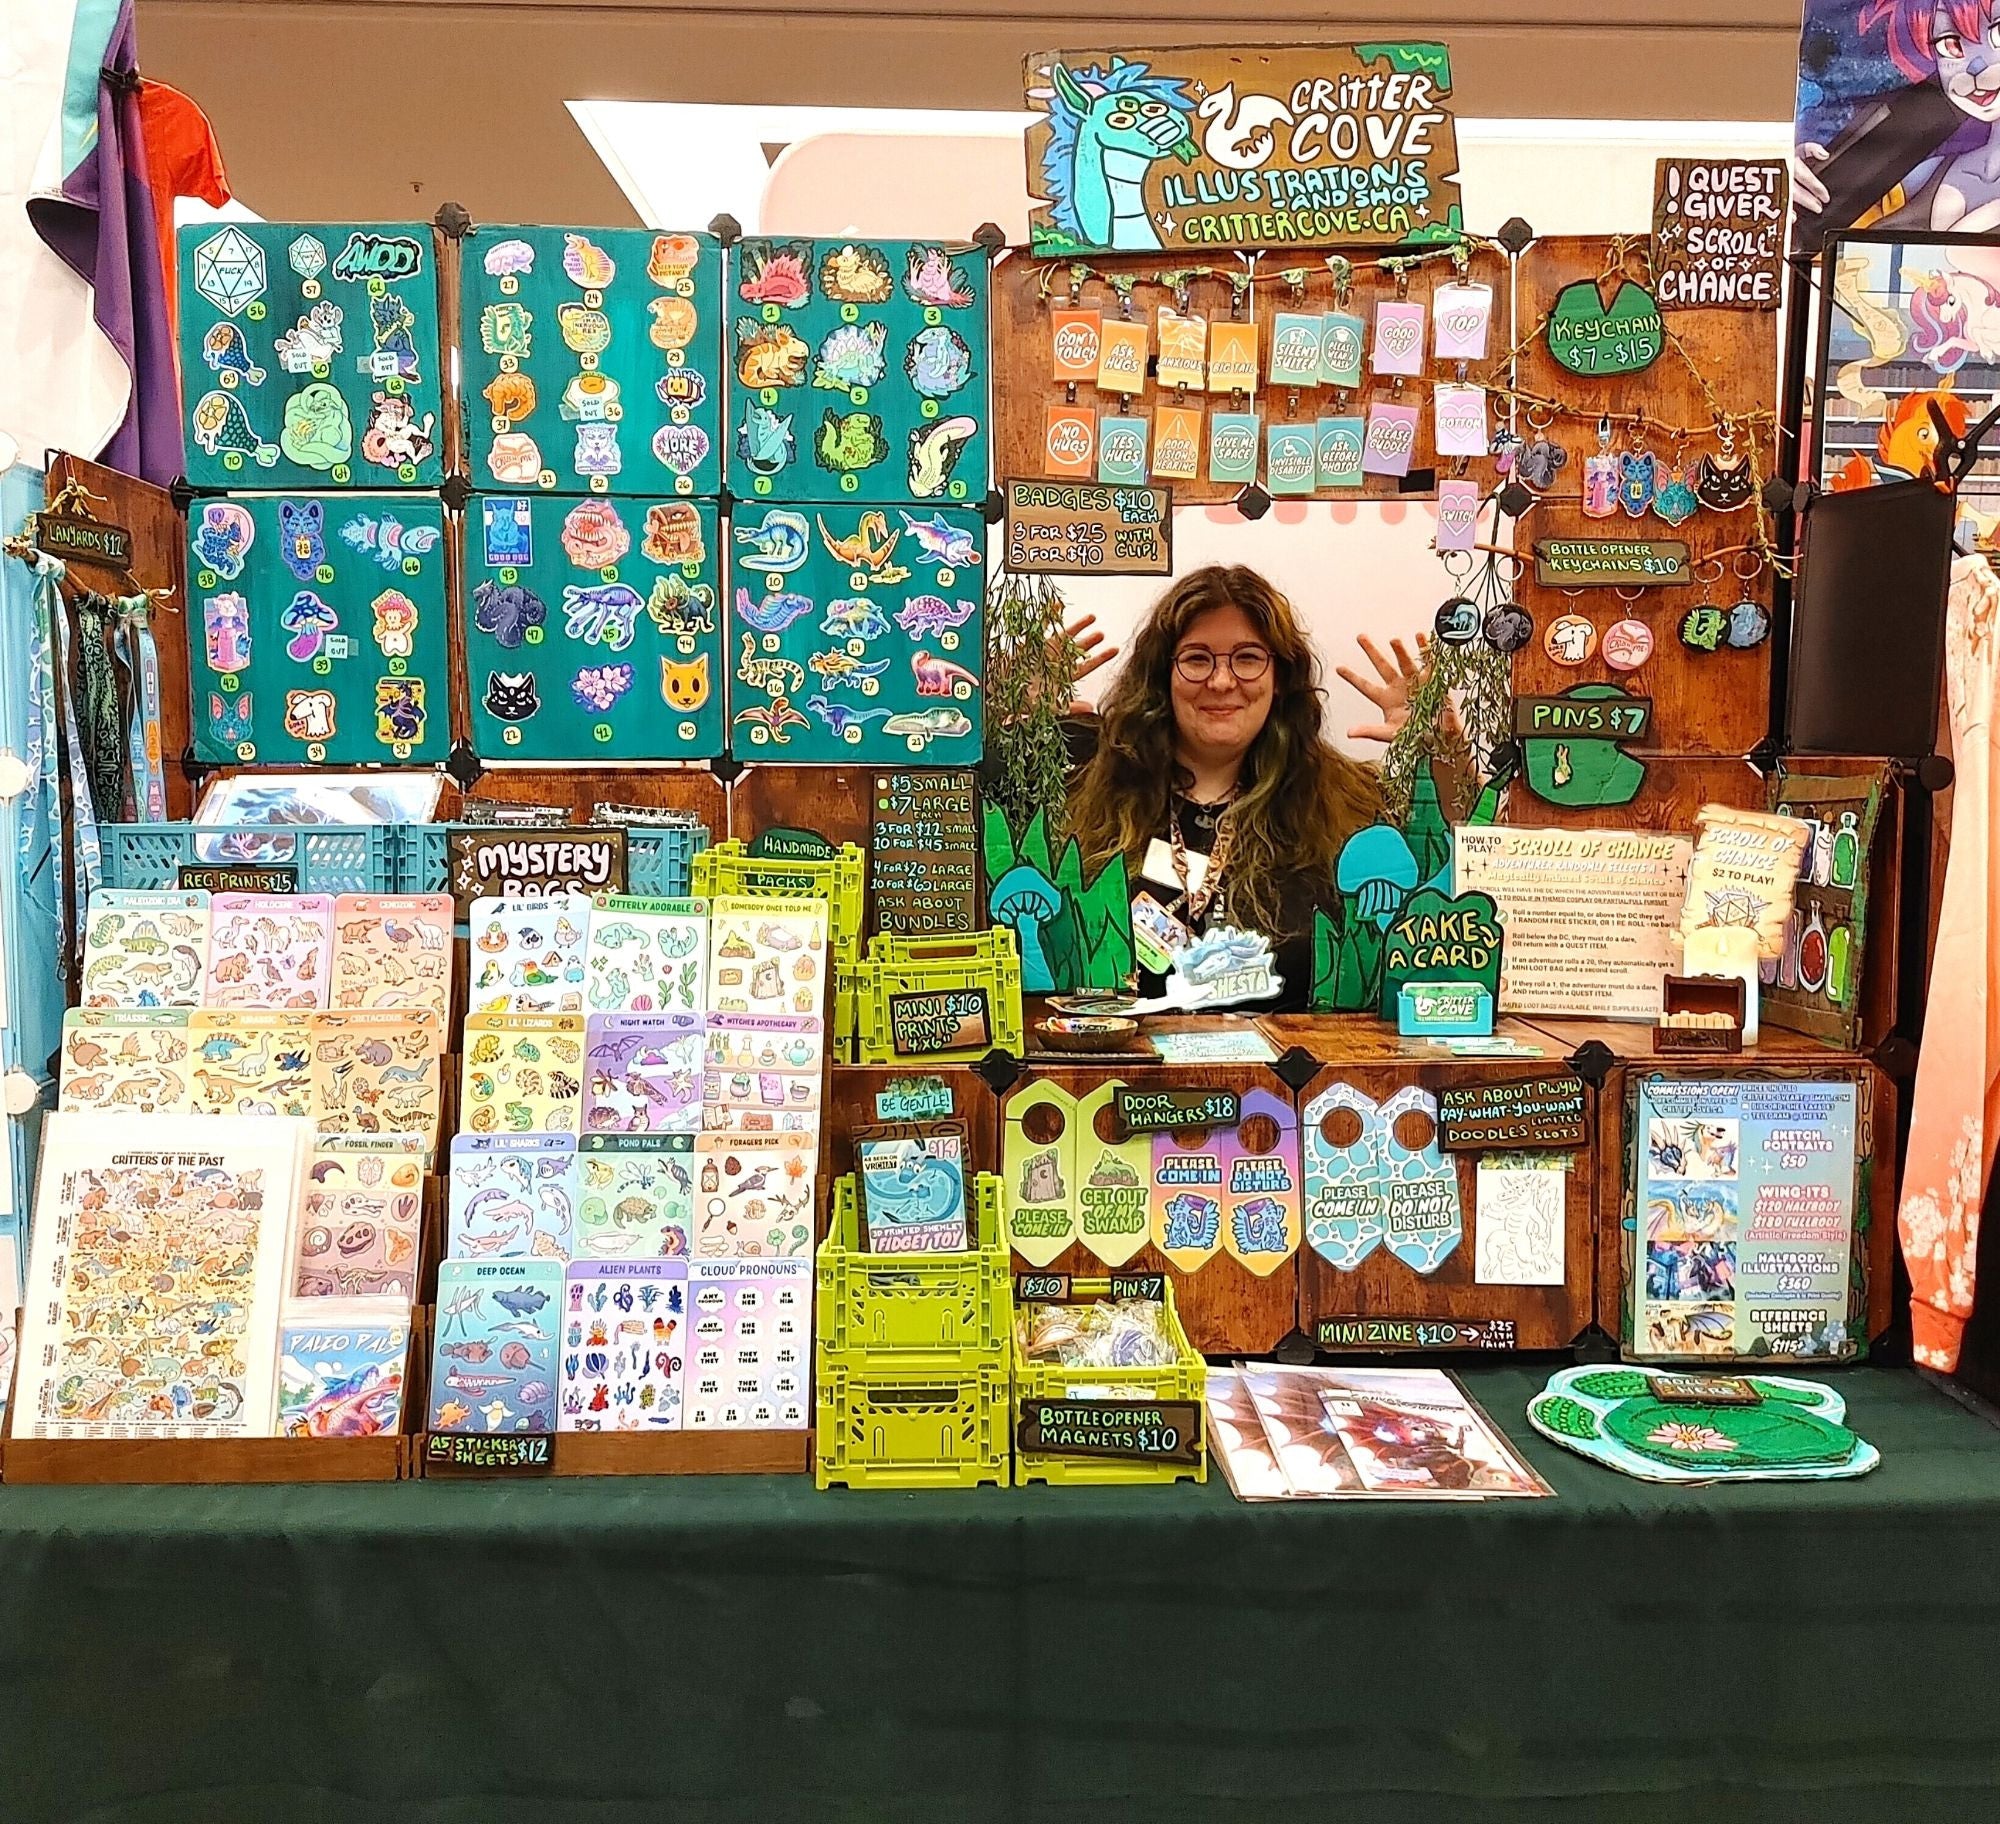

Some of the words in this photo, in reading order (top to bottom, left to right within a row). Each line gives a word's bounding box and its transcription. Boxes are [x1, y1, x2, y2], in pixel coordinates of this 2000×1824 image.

[1291, 112, 1445, 162] COVE
[1163, 159, 1428, 207] ILLUSTRATIONS
[1688, 167, 1781, 193] QUEST
[1291, 192, 1352, 210] AND
[1355, 186, 1430, 207] SHOP
[1684, 193, 1781, 220] GIVER
[1687, 227, 1774, 258] SCROLL
[1715, 257, 1737, 270] OF
[503, 281, 514, 290] 27
[1659, 270, 1773, 302] CHANCE
[587, 294, 599, 304] 24
[250, 306, 264, 316] 56
[928, 310, 937, 321] 3
[1447, 316, 1478, 330] TOP
[1555, 313, 1661, 340] KEYCHAIN
[1384, 327, 1415, 339] GOOD
[1389, 338, 1409, 350] PET
[1057, 346, 1097, 360] TOUCH
[1110, 345, 1135, 358] ASK
[1105, 359, 1140, 372] HUGS
[855, 391, 863, 401] 5
[1061, 425, 1080, 437] NO
[1053, 440, 1087, 451] HUGS
[1112, 436, 1134, 448] YES
[1105, 450, 1140, 463] HUGS
[1217, 449, 1251, 460] SPACE
[1322, 452, 1357, 461] BEFORE
[400, 469, 413, 478] 65
[1015, 486, 1110, 510] BADGES
[1114, 490, 1154, 511] $10
[1123, 511, 1159, 523] EACH
[1440, 510, 1475, 521] SWITCH
[50, 524, 100, 550] LANYARDS
[1014, 522, 1026, 541] 3
[1030, 526, 1062, 539] FOR
[1067, 524, 1106, 542] $25
[1115, 528, 1153, 541] WITH
[1011, 543, 1026, 563] 5
[1029, 548, 1065, 561] FOR
[1067, 545, 1104, 566] $40
[1116, 542, 1157, 560] CLIP!
[1551, 544, 1597, 555] BOTTLE
[1601, 544, 1651, 556] OPENER
[1551, 559, 1641, 573] KEYCHAINS
[1643, 558, 1677, 574] $10
[503, 570, 515, 580] 43
[1534, 706, 1603, 729] PINS
[1611, 707, 1644, 733] $7
[891, 776, 910, 792] $5
[913, 778, 971, 791] SMALL
[891, 796, 911, 815] $7
[913, 798, 970, 811] LARGE
[876, 823, 887, 834] 3
[889, 824, 913, 834] FOR
[916, 821, 943, 836] $12
[946, 825, 978, 833] SMALL
[764, 836, 832, 858] HANDMADE
[874, 838, 890, 850] 10
[894, 839, 914, 848] FOR
[918, 839, 942, 851] $45
[1462, 836, 1485, 844] HOW
[1506, 838, 1573, 857] SCROLL
[1582, 841, 1602, 856] OF
[478, 841, 610, 883] MYSTERY
[874, 861, 881, 874] 4
[884, 864, 902, 872] FOR
[932, 865, 972, 875] LARGE
[220, 872, 270, 890] PRINTS
[1712, 868, 1725, 878] $2
[1727, 870, 1742, 879] TO
[1744, 872, 1775, 885] PLAY!
[871, 880, 884, 889] 10
[887, 881, 904, 889] FOR
[934, 881, 973, 891] LARGE
[609, 900, 647, 911] OTTERLY
[650, 902, 692, 913] ADORABLE
[878, 897, 905, 907] ASK
[913, 898, 963, 910] ABOUT
[880, 912, 969, 930] BUNDLES
[1396, 911, 1478, 946] TAKE
[1390, 951, 1406, 969] A
[1413, 945, 1489, 970] CARD
[897, 1001, 940, 1018] MINI
[946, 995, 982, 1014] $10
[620, 1018, 641, 1027] NIGHT
[643, 1018, 665, 1026] WATCH
[898, 1017, 960, 1037] PRINTS
[882, 1098, 896, 1111] BE
[900, 1093, 949, 1111] GENTLE!
[1444, 1091, 1475, 1106] ASK
[1483, 1084, 1533, 1103] ABOUT
[1124, 1096, 1174, 1110] DOOR
[1131, 1109, 1206, 1126] HANGERS
[1206, 1098, 1234, 1118] $18
[1449, 1125, 1528, 1142] DOODLES
[1534, 1128, 1578, 1140] SLOTS
[1771, 1130, 1822, 1140] SKETCH
[1763, 1140, 1833, 1151] PORTRAITS
[112, 1155, 158, 1165] CRITTERS
[162, 1156, 174, 1165] OF
[178, 1156, 195, 1165] THE
[199, 1156, 225, 1166] PAST
[1781, 1154, 1808, 1168] $50
[1082, 1190, 1115, 1204] GET
[1118, 1190, 1148, 1204] OUT
[1323, 1187, 1367, 1199] PLEASE
[1393, 1184, 1445, 1198] PLEASE
[1760, 1186, 1830, 1198] WING-ITS
[1313, 1200, 1357, 1217] COME
[1016, 1212, 1066, 1224] PLEASE
[1086, 1217, 1142, 1233] SWAMP
[1393, 1214, 1450, 1231] DISTURB
[877, 1233, 929, 1252] FIDGET
[932, 1231, 962, 1249] TOY
[477, 1267, 497, 1275] DEEP
[499, 1266, 526, 1275] OCEAN
[598, 1265, 625, 1275] ALIEN
[628, 1265, 662, 1275] PLANTS
[701, 1266, 735, 1276] CLOUD
[740, 1265, 797, 1275] PRONOUNS
[1742, 1263, 1838, 1274] ILLUSTRATIONS
[1025, 1279, 1062, 1295] $10
[1113, 1280, 1138, 1296] PIN
[1141, 1278, 1161, 1299] $7
[1750, 1311, 1826, 1322] REFERENCE
[1320, 1323, 1363, 1343] MINI
[1368, 1323, 1413, 1342] ZINE
[1416, 1324, 1456, 1345] $10
[1764, 1322, 1813, 1333] SHEETS
[1040, 1407, 1100, 1425] BOTTLE
[1102, 1411, 1162, 1426] OPENER
[455, 1437, 518, 1450] STICKER
[1042, 1428, 1133, 1446] MAGNETS
[1138, 1428, 1177, 1451] $10
[455, 1452, 518, 1465] SHEETS
[518, 1438, 548, 1463] $12
